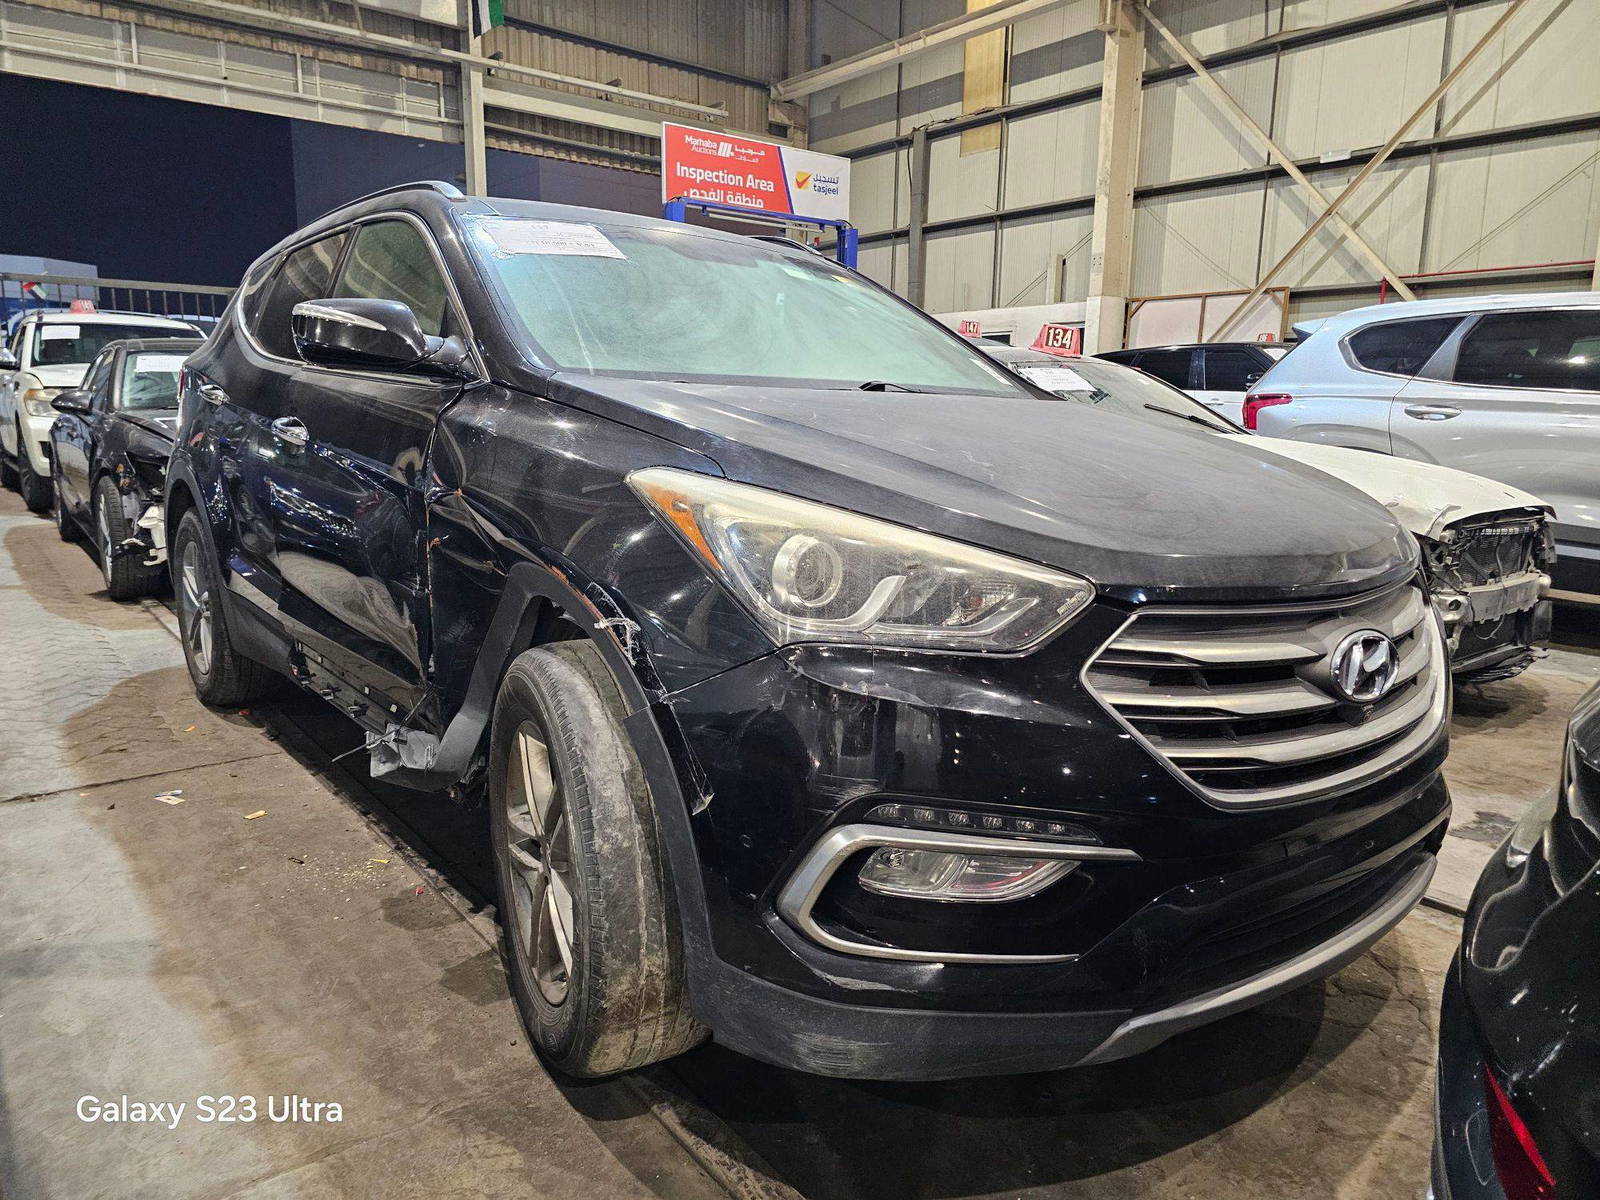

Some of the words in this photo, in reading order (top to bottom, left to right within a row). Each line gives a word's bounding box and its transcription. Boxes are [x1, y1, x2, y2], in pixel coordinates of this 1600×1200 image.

[684, 134, 718, 150] Marhaba
[691, 144, 718, 156] Auctions
[676, 161, 744, 184] Inspection
[745, 174, 775, 192] Area
[813, 182, 839, 196] tasjeel
[726, 190, 764, 208] منطقة
[965, 320, 979, 334] 147
[1047, 326, 1073, 350] 134
